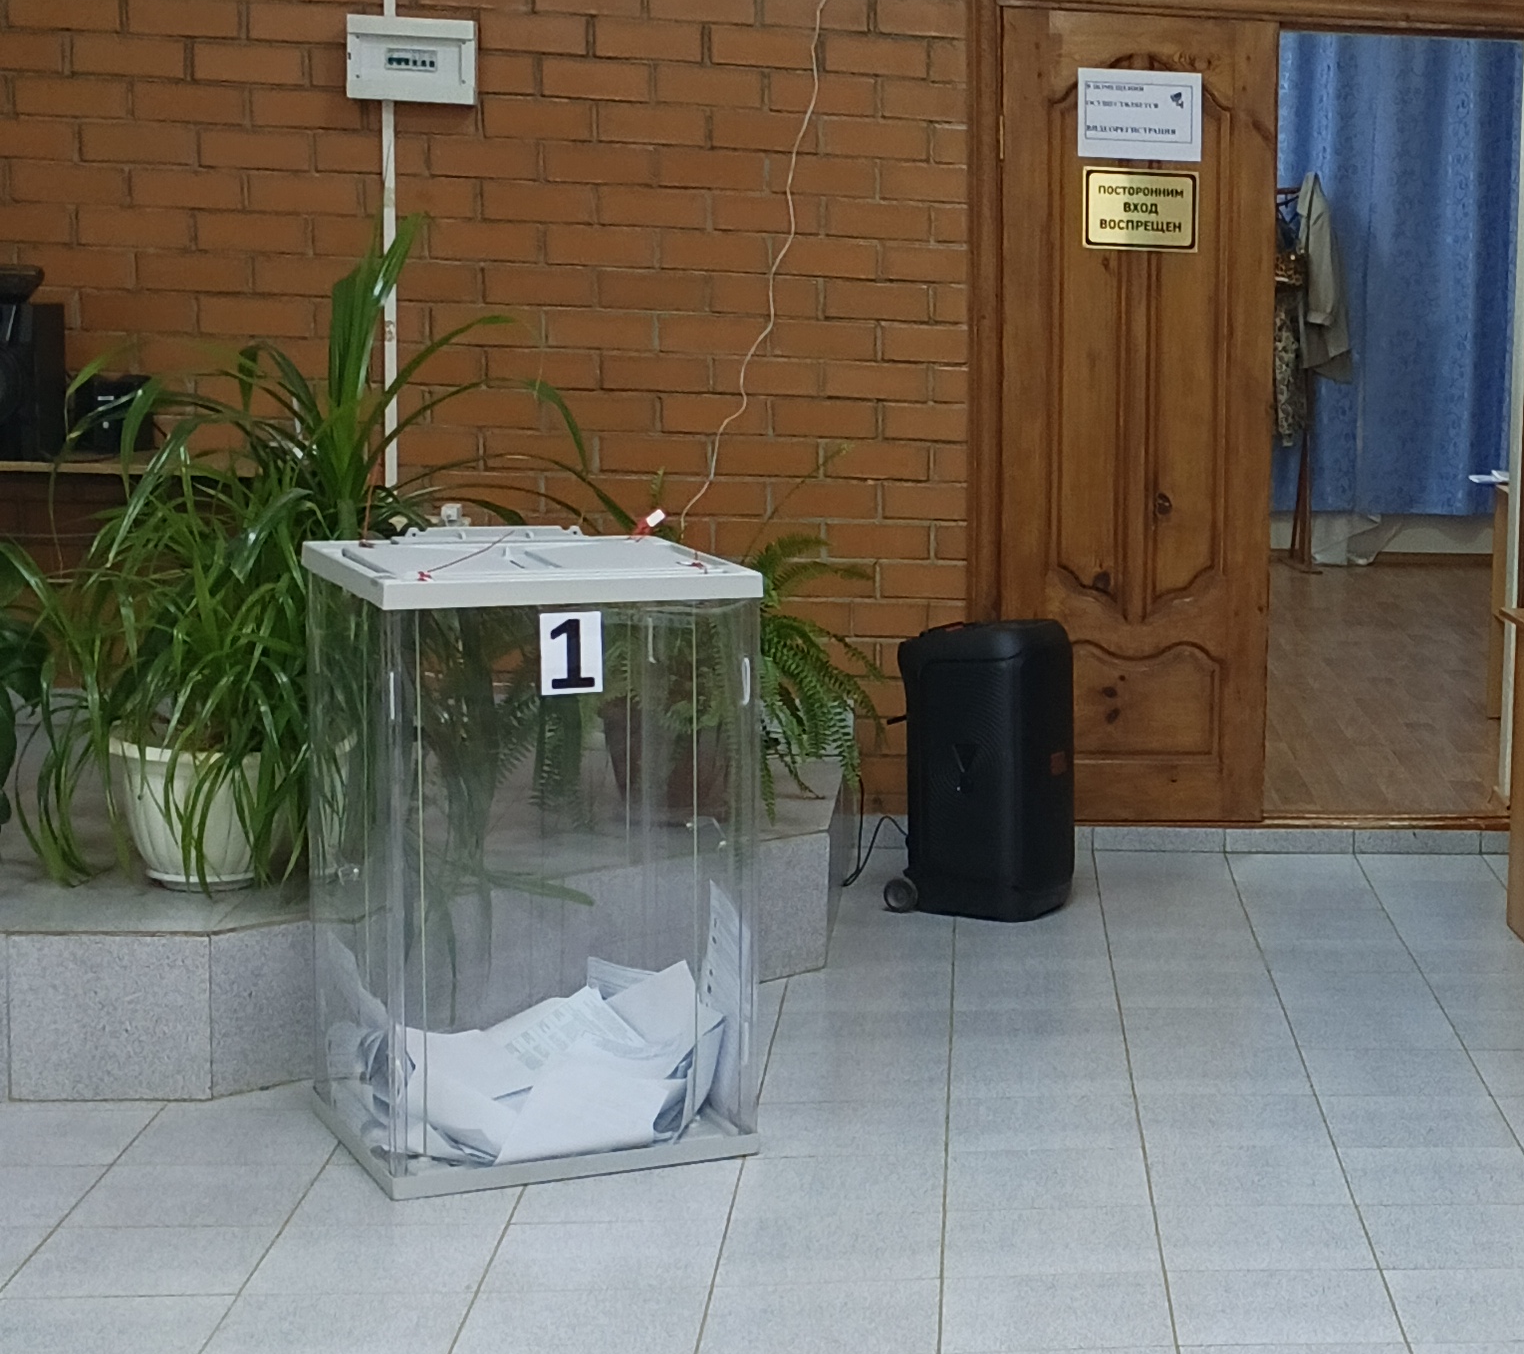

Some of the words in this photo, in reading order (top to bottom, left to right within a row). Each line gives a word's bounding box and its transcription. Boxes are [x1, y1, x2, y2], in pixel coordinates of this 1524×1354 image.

[1098, 185, 1184, 199] ПОСТОРОННИМ
[1123, 202, 1159, 216] ВХОД
[1099, 218, 1182, 233] ВОСПРЕЩЕН
[551, 619, 595, 689] 1
